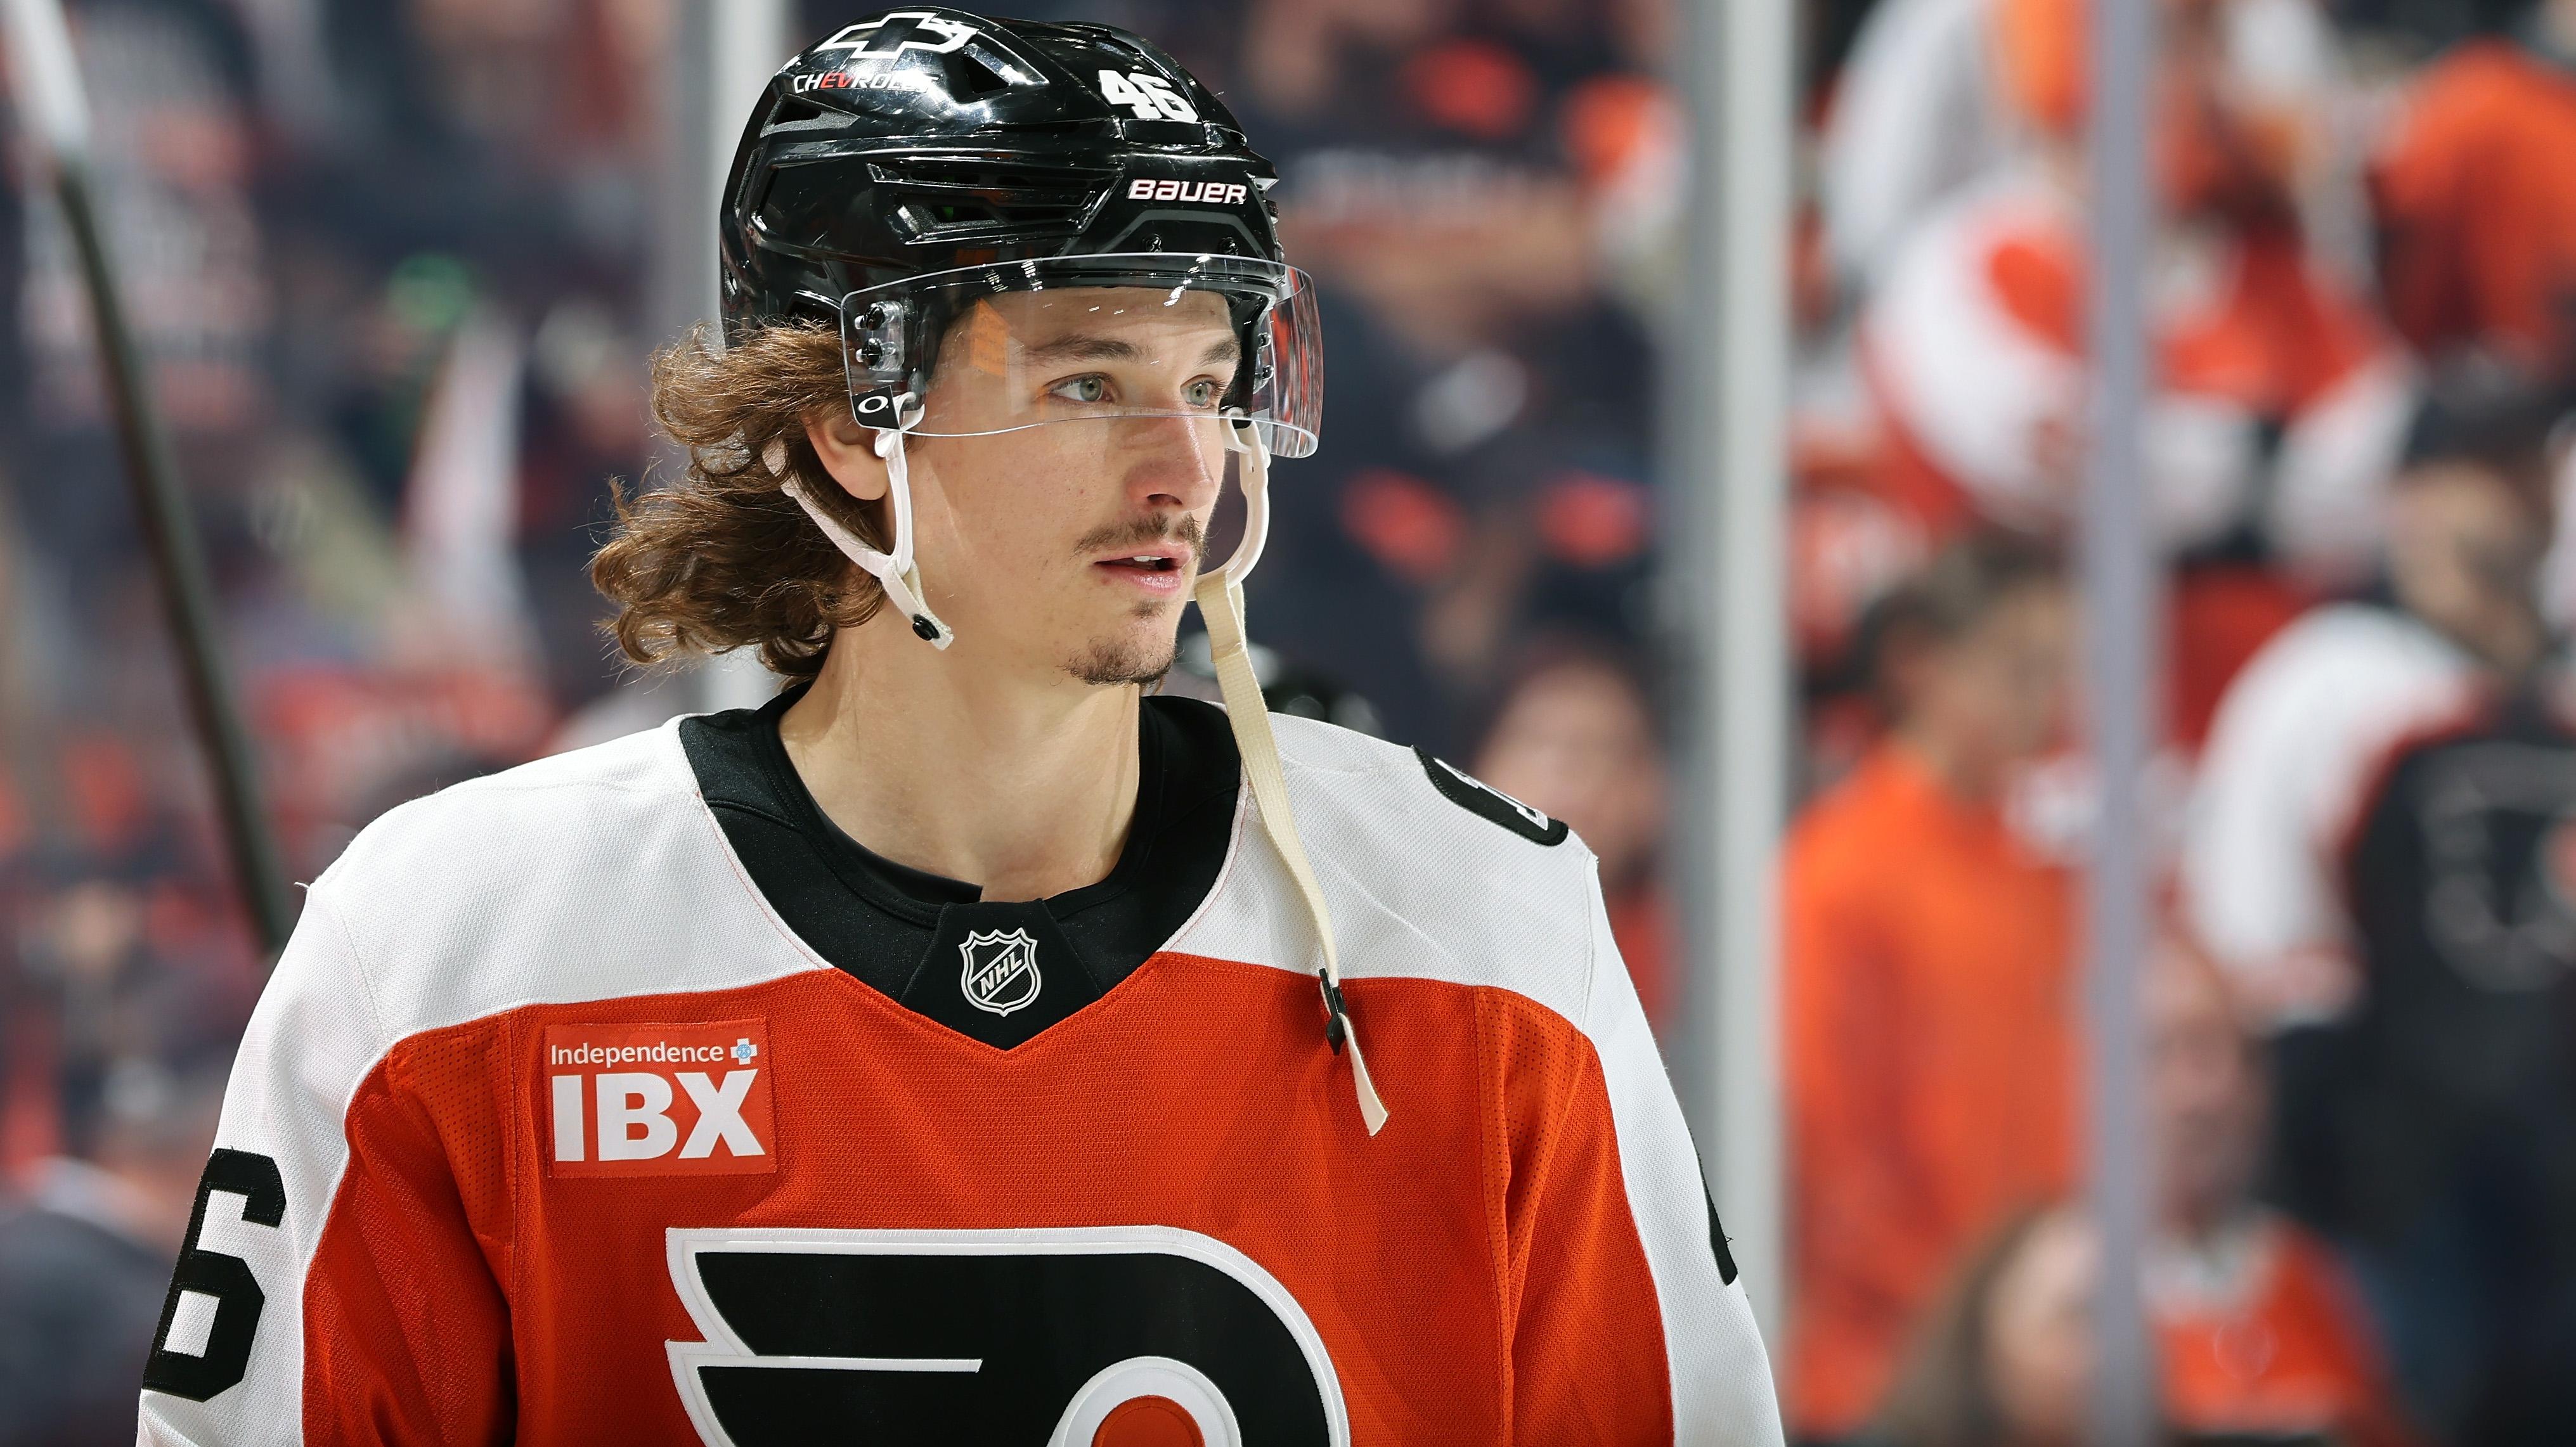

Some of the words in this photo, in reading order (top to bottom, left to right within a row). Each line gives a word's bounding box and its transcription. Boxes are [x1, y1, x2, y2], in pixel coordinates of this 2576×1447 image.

[794, 72, 940, 94] CHEVROL
[1098, 69, 1199, 124] 46
[979, 951, 1023, 997] NHL
[550, 1041, 724, 1068] Independence
[552, 1069, 766, 1162] IBX
